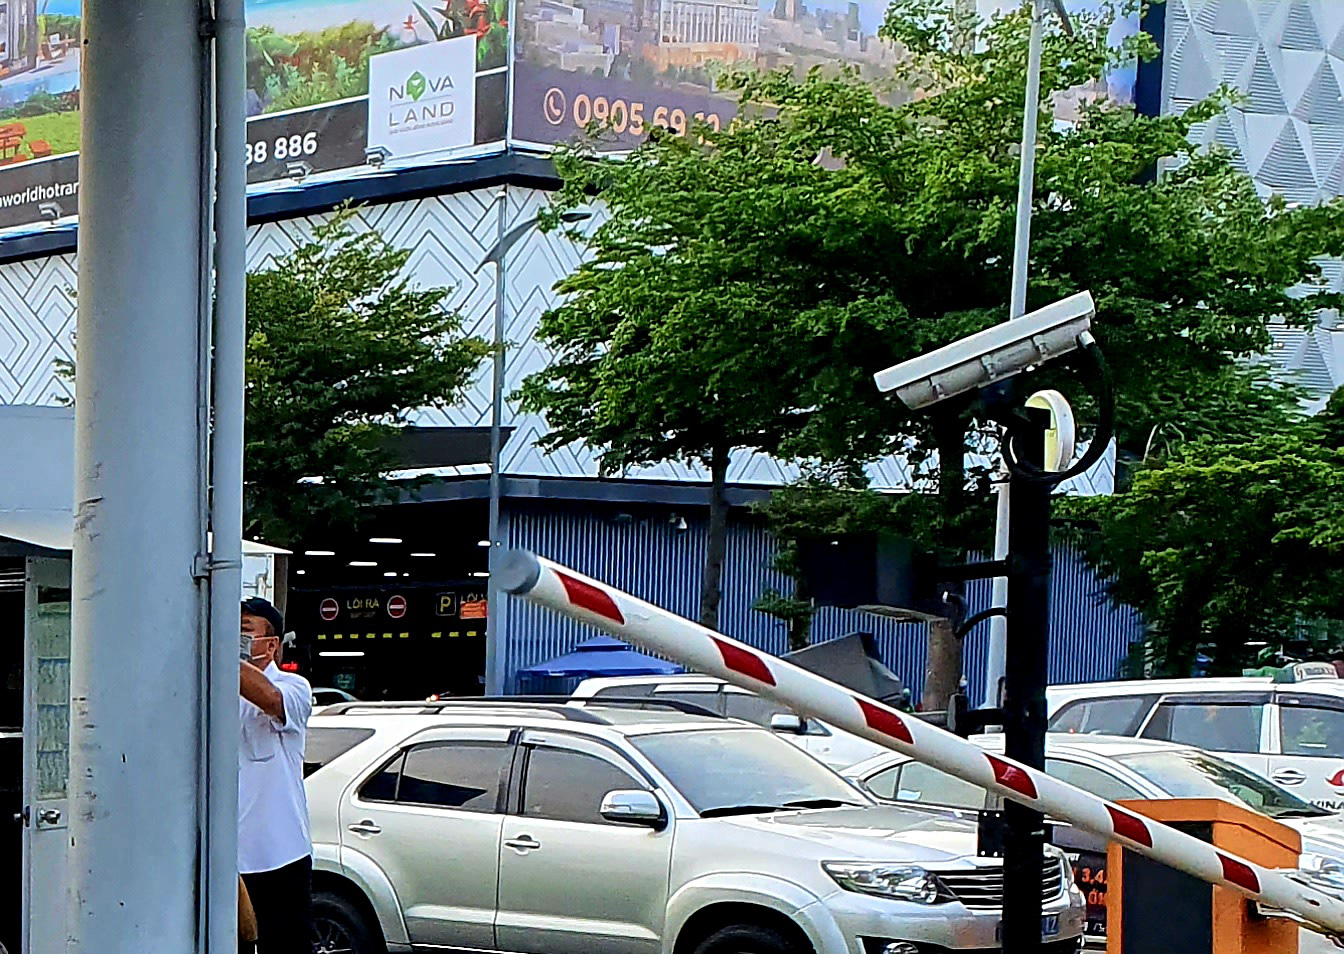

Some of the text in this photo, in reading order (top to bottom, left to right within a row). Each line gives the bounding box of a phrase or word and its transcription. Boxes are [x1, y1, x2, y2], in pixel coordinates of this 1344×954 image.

[388, 101, 455, 127] LAND
[573, 94, 645, 136] 0905
[274, 131, 318, 160] 886
